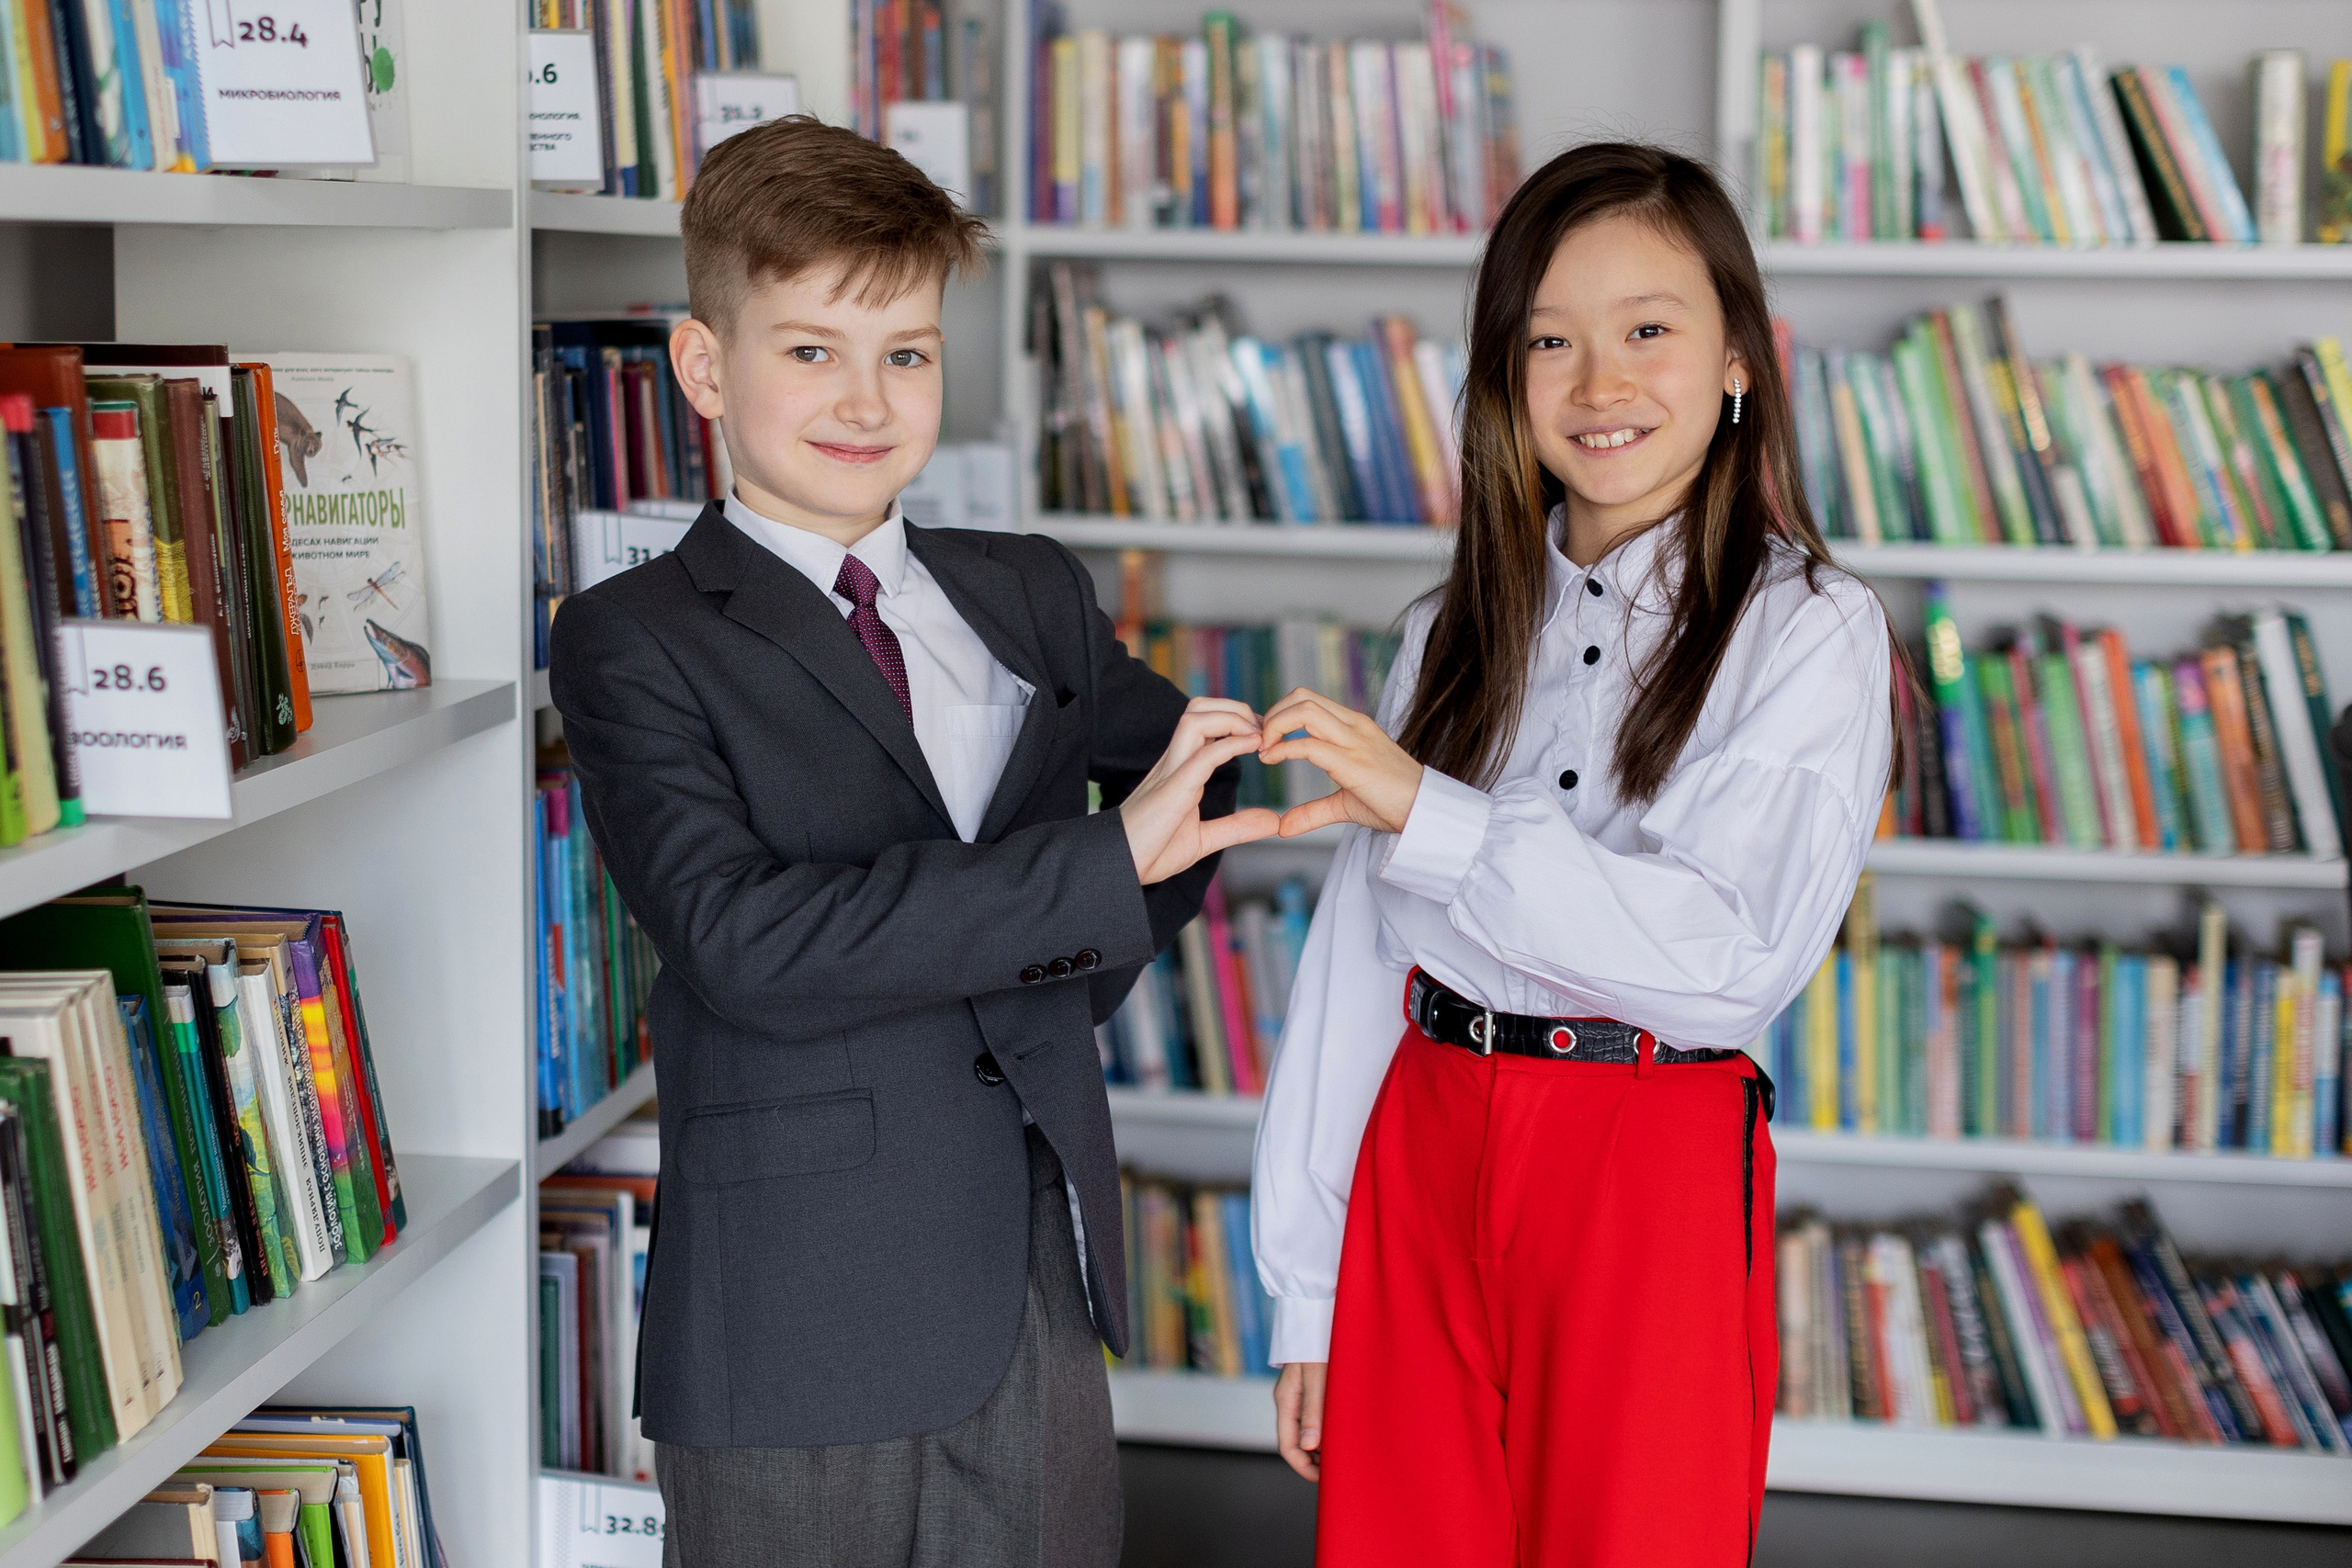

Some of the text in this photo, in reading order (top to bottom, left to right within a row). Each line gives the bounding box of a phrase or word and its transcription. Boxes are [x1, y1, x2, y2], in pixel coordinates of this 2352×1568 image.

[238, 16, 308, 48] 28.4
[219, 88, 342, 102] МИКРОБИОЛОГИЯ
[529, 63, 558, 85] .6
[323, 536, 379, 547] НАВИГАЦИИ
[345, 550, 371, 559] МИРЕ
[284, 567, 299, 635] ДЖЕРАЛЬД
[94, 665, 167, 692] 28.6
[289, 999, 308, 1064] ЖИВОТНЫХ
[302, 1063, 319, 1122] ЭКОЛОГИИ
[272, 998, 325, 1252] ПОПУЛЯРНАЯ ЭНЦИКЛОПЕДИЯ ЖИВОТНЫХ
[313, 1122, 330, 1183] ОСНОВАМИ
[192, 1159, 214, 1247] ЗООЛОГИЯ
[324, 1191, 342, 1249] ЗООЛОГИЯ
[192, 1291, 202, 1311] 2
